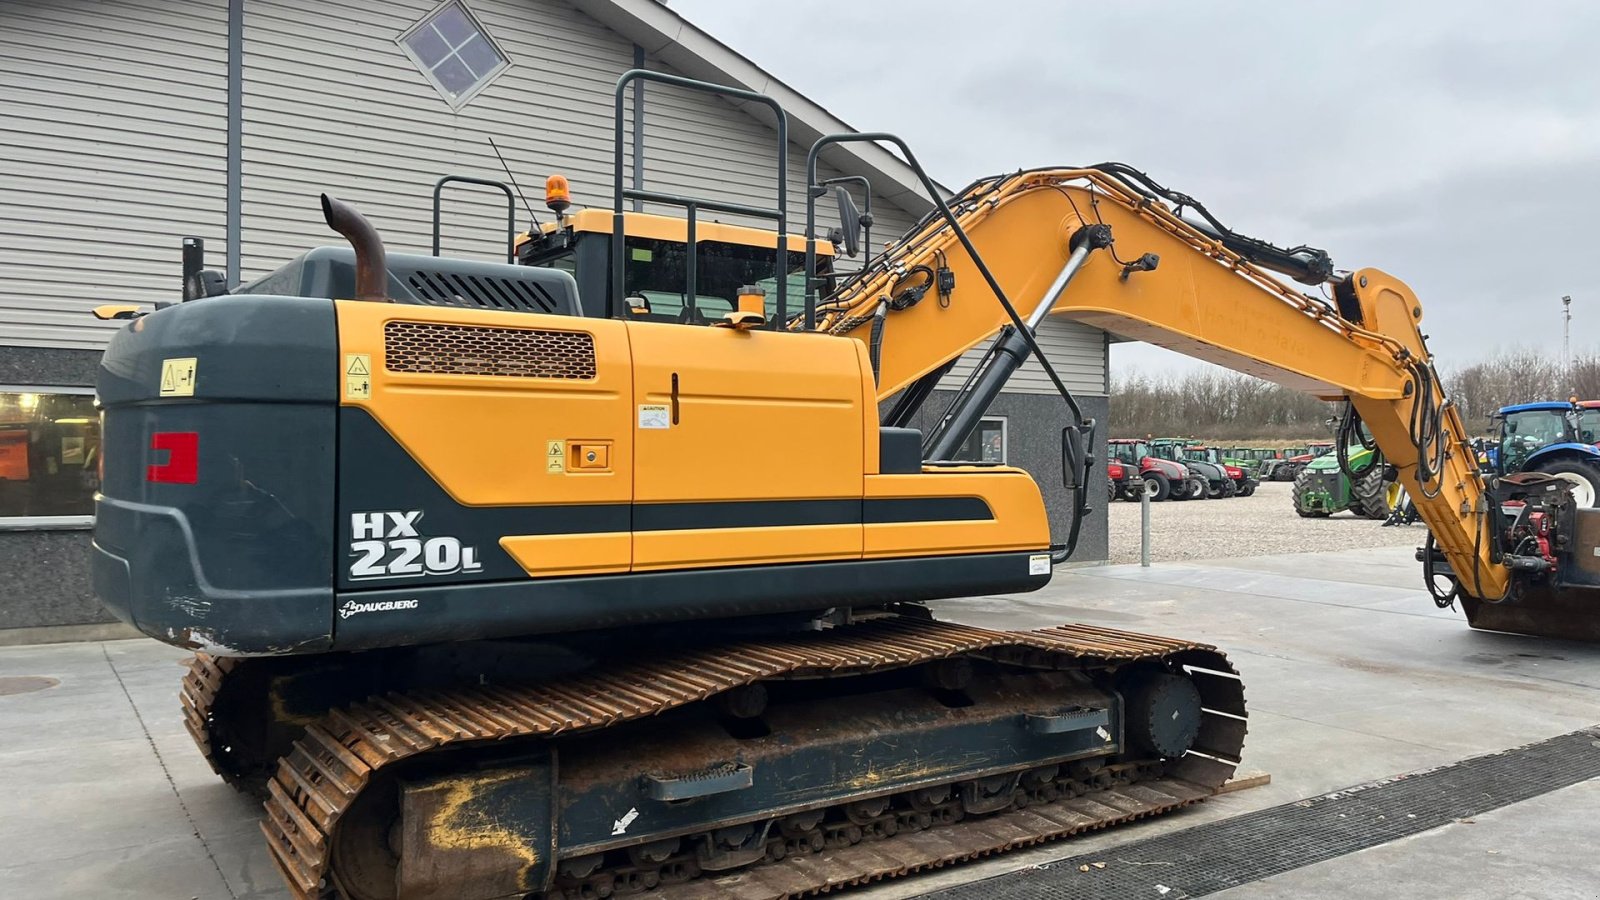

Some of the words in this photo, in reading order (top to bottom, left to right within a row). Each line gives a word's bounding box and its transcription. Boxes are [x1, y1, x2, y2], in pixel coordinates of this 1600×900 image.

[351, 511, 422, 539] HX
[350, 537, 482, 578] 220L
[355, 600, 418, 613] DAUGBJERG
